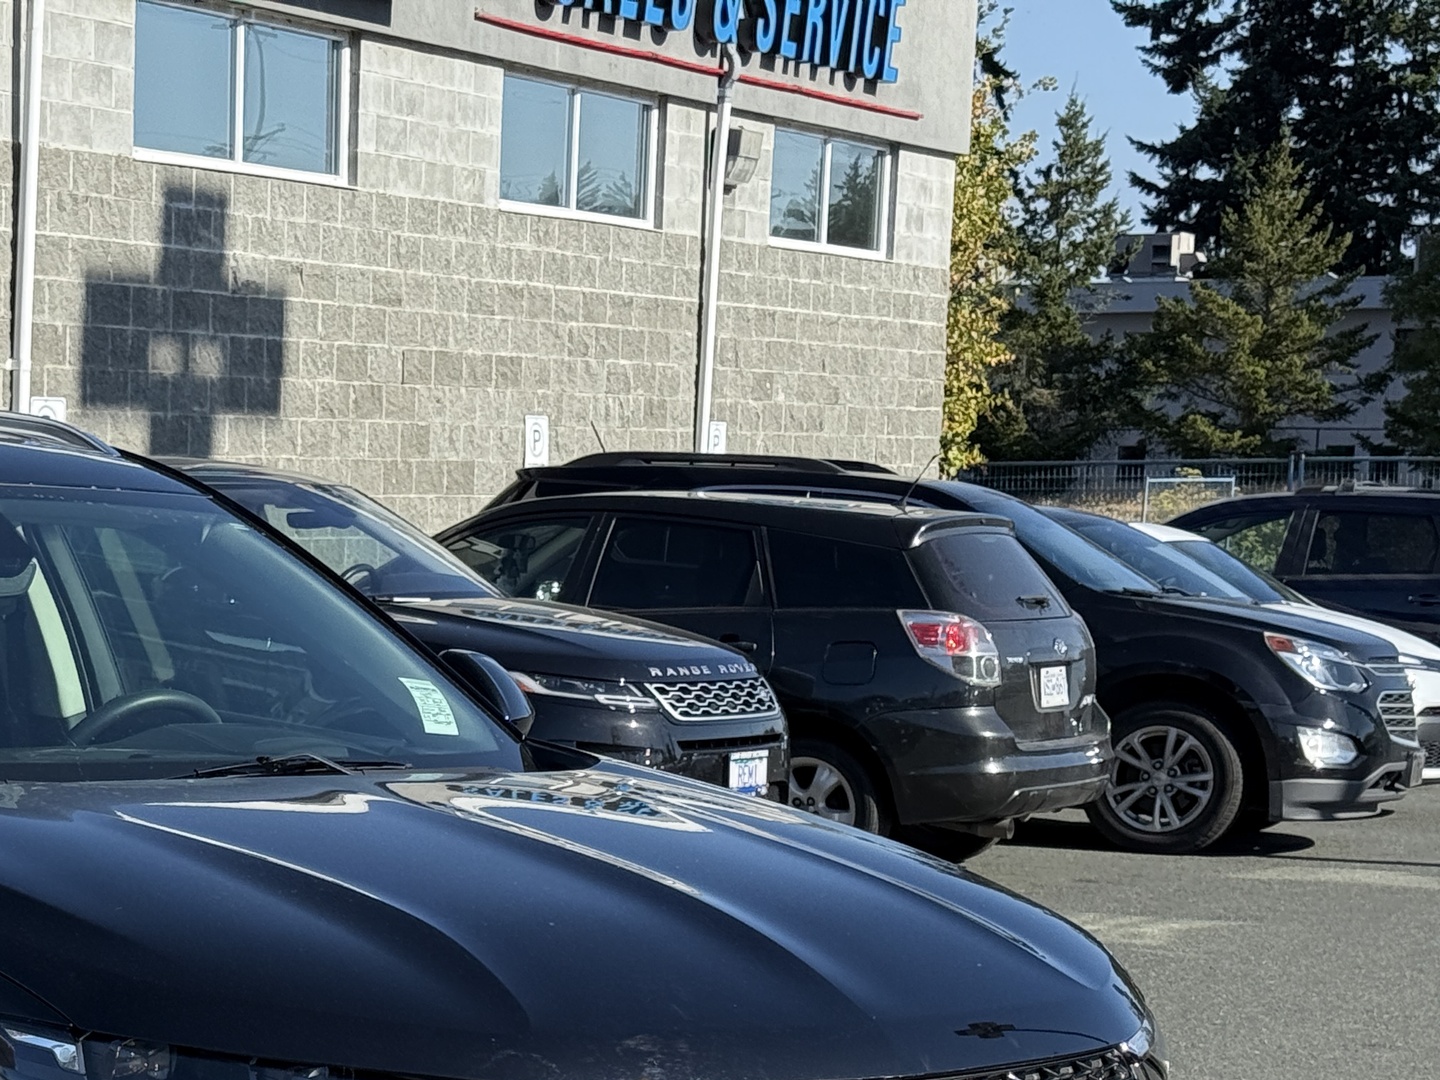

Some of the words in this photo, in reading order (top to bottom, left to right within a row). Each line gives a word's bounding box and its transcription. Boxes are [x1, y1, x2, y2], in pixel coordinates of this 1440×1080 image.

[756, 0, 906, 83] SERVICE
[648, 665, 712, 677] RANGE
[718, 663, 757, 674] ROVER
